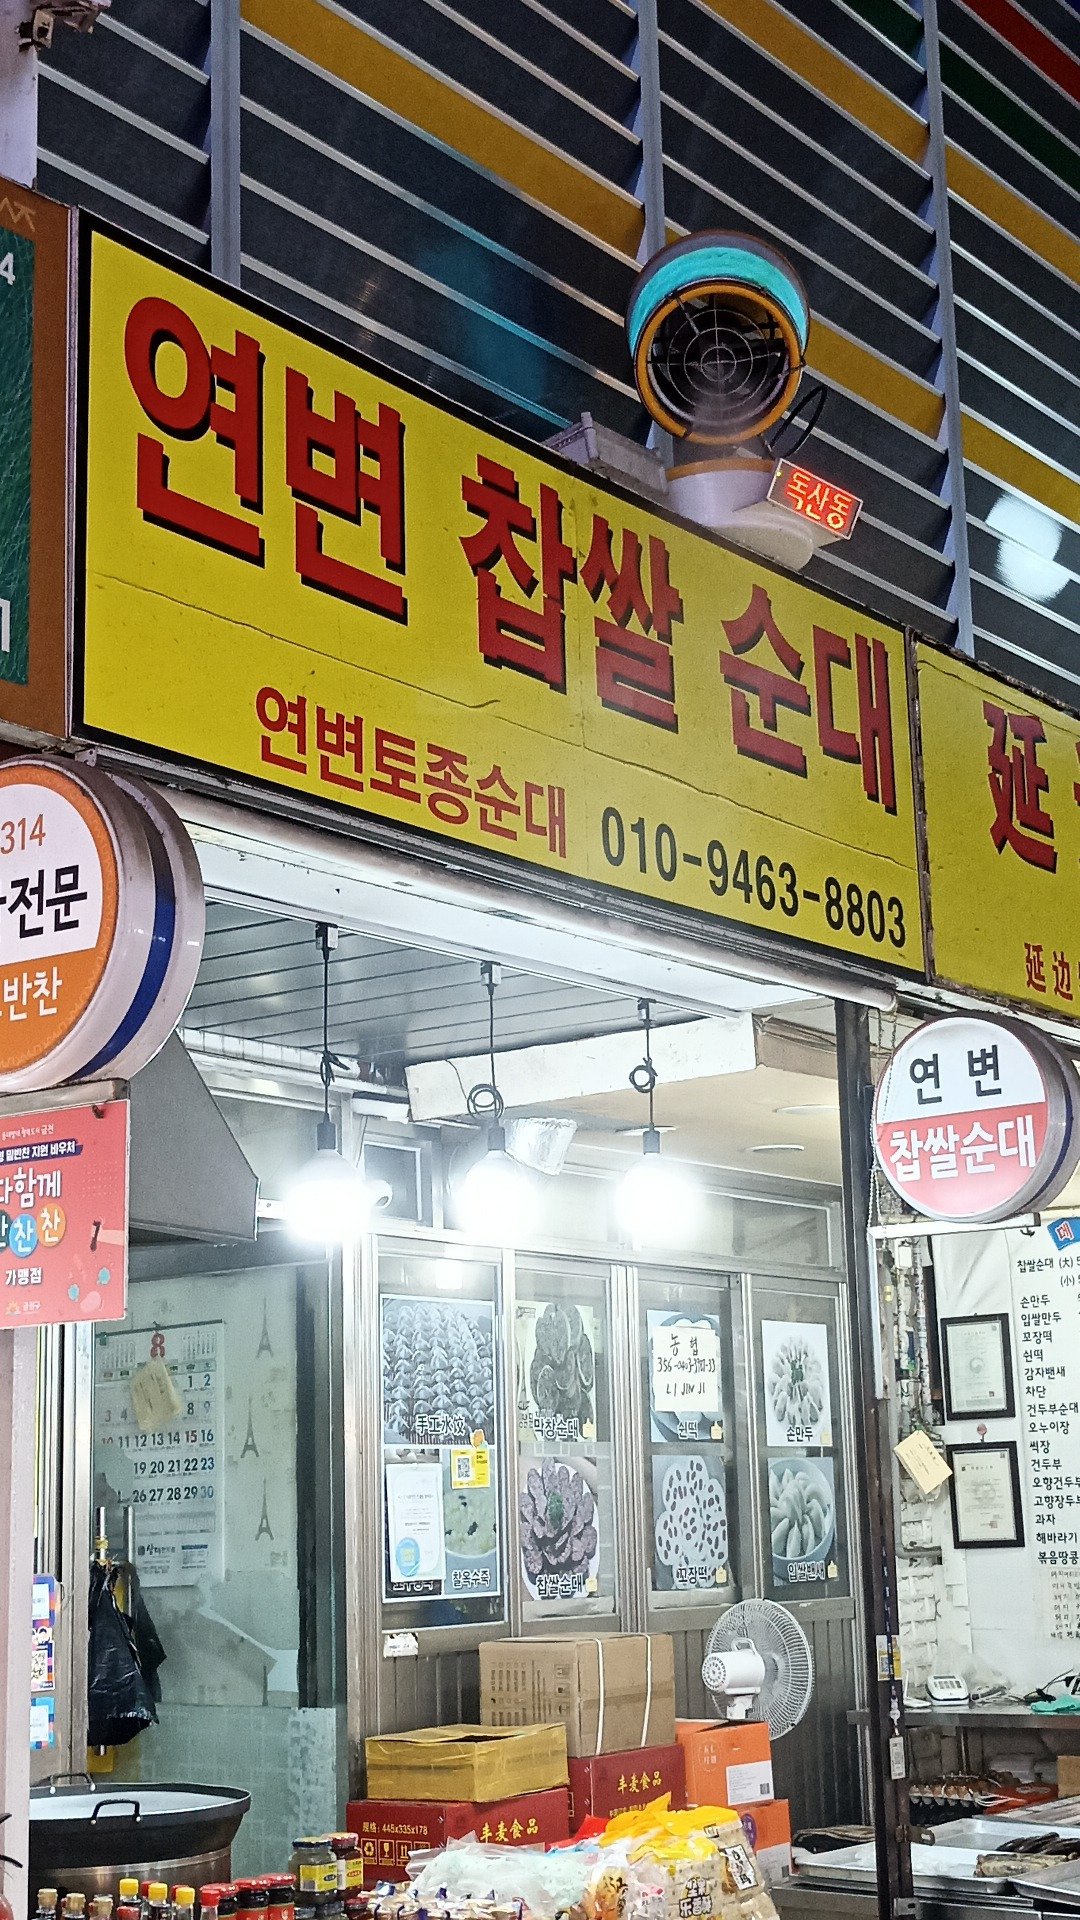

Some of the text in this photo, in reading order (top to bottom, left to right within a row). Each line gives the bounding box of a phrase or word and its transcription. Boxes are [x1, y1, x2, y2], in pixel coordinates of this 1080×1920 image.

[785, 470, 852, 530] 독산동
[124, 297, 897, 816] 연변 찹쌀 순대
[256, 686, 567, 859] 연변토종순대
[983, 700, 1080, 874] 延
[601, 806, 907, 949] 010-9463-8803
[0, 864, 88, 939] 전문
[1024, 942, 1080, 1001] 延边
[0, 966, 63, 1022] 반찬
[32, 1144, 49, 1158] 지원
[50, 1140, 76, 1156] 바우처
[889, 1114, 1036, 1183] 찹쌀순대
[1017, 1257, 1054, 1273] 찹쌀순대
[1059, 1257, 1074, 1270] (大)
[5, 1266, 42, 1286] 가맹점
[1061, 1275, 1075, 1288] (小)
[1020, 1294, 1050, 1309] 손만두
[1021, 1312, 1062, 1327] 입쌀만두
[1022, 1330, 1053, 1344] 꼬장떡
[1023, 1349, 1044, 1363] 쉰떡
[188, 1373, 211, 1388] 1 2
[1025, 1385, 1047, 1399] 차단
[104, 1400, 211, 1423] 3 4 8 9
[1026, 1401, 1079, 1417] 건두부순대
[533, 1418, 579, 1438] 막창순대
[678, 1421, 698, 1439] 쉰떡
[786, 1426, 814, 1443] 손만두
[1028, 1421, 1070, 1435] 오누이장
[118, 1436, 130, 1448] 11
[135, 1434, 147, 1447] 12
[152, 1433, 164, 1446] 13
[168, 1431, 180, 1445] 14
[185, 1430, 197, 1443] 15
[201, 1429, 214, 1442] 16
[134, 1457, 215, 1475] 19 20 21 22 23
[1031, 1458, 1062, 1472] 건두부
[132, 1485, 214, 1503] 26 27 28 29 30
[1035, 1513, 1056, 1525] 과자
[1036, 1532, 1078, 1545] 해바라기
[1038, 1550, 1079, 1565] 볶음땅콩
[452, 1570, 490, 1588] 찰옥수죽
[676, 1566, 708, 1584] 꼬장떡
[536, 1575, 583, 1596] 찹쌀순대
[617, 1771, 662, 1794] 丰麦食品
[479, 1818, 539, 1844] 丰麦食品
